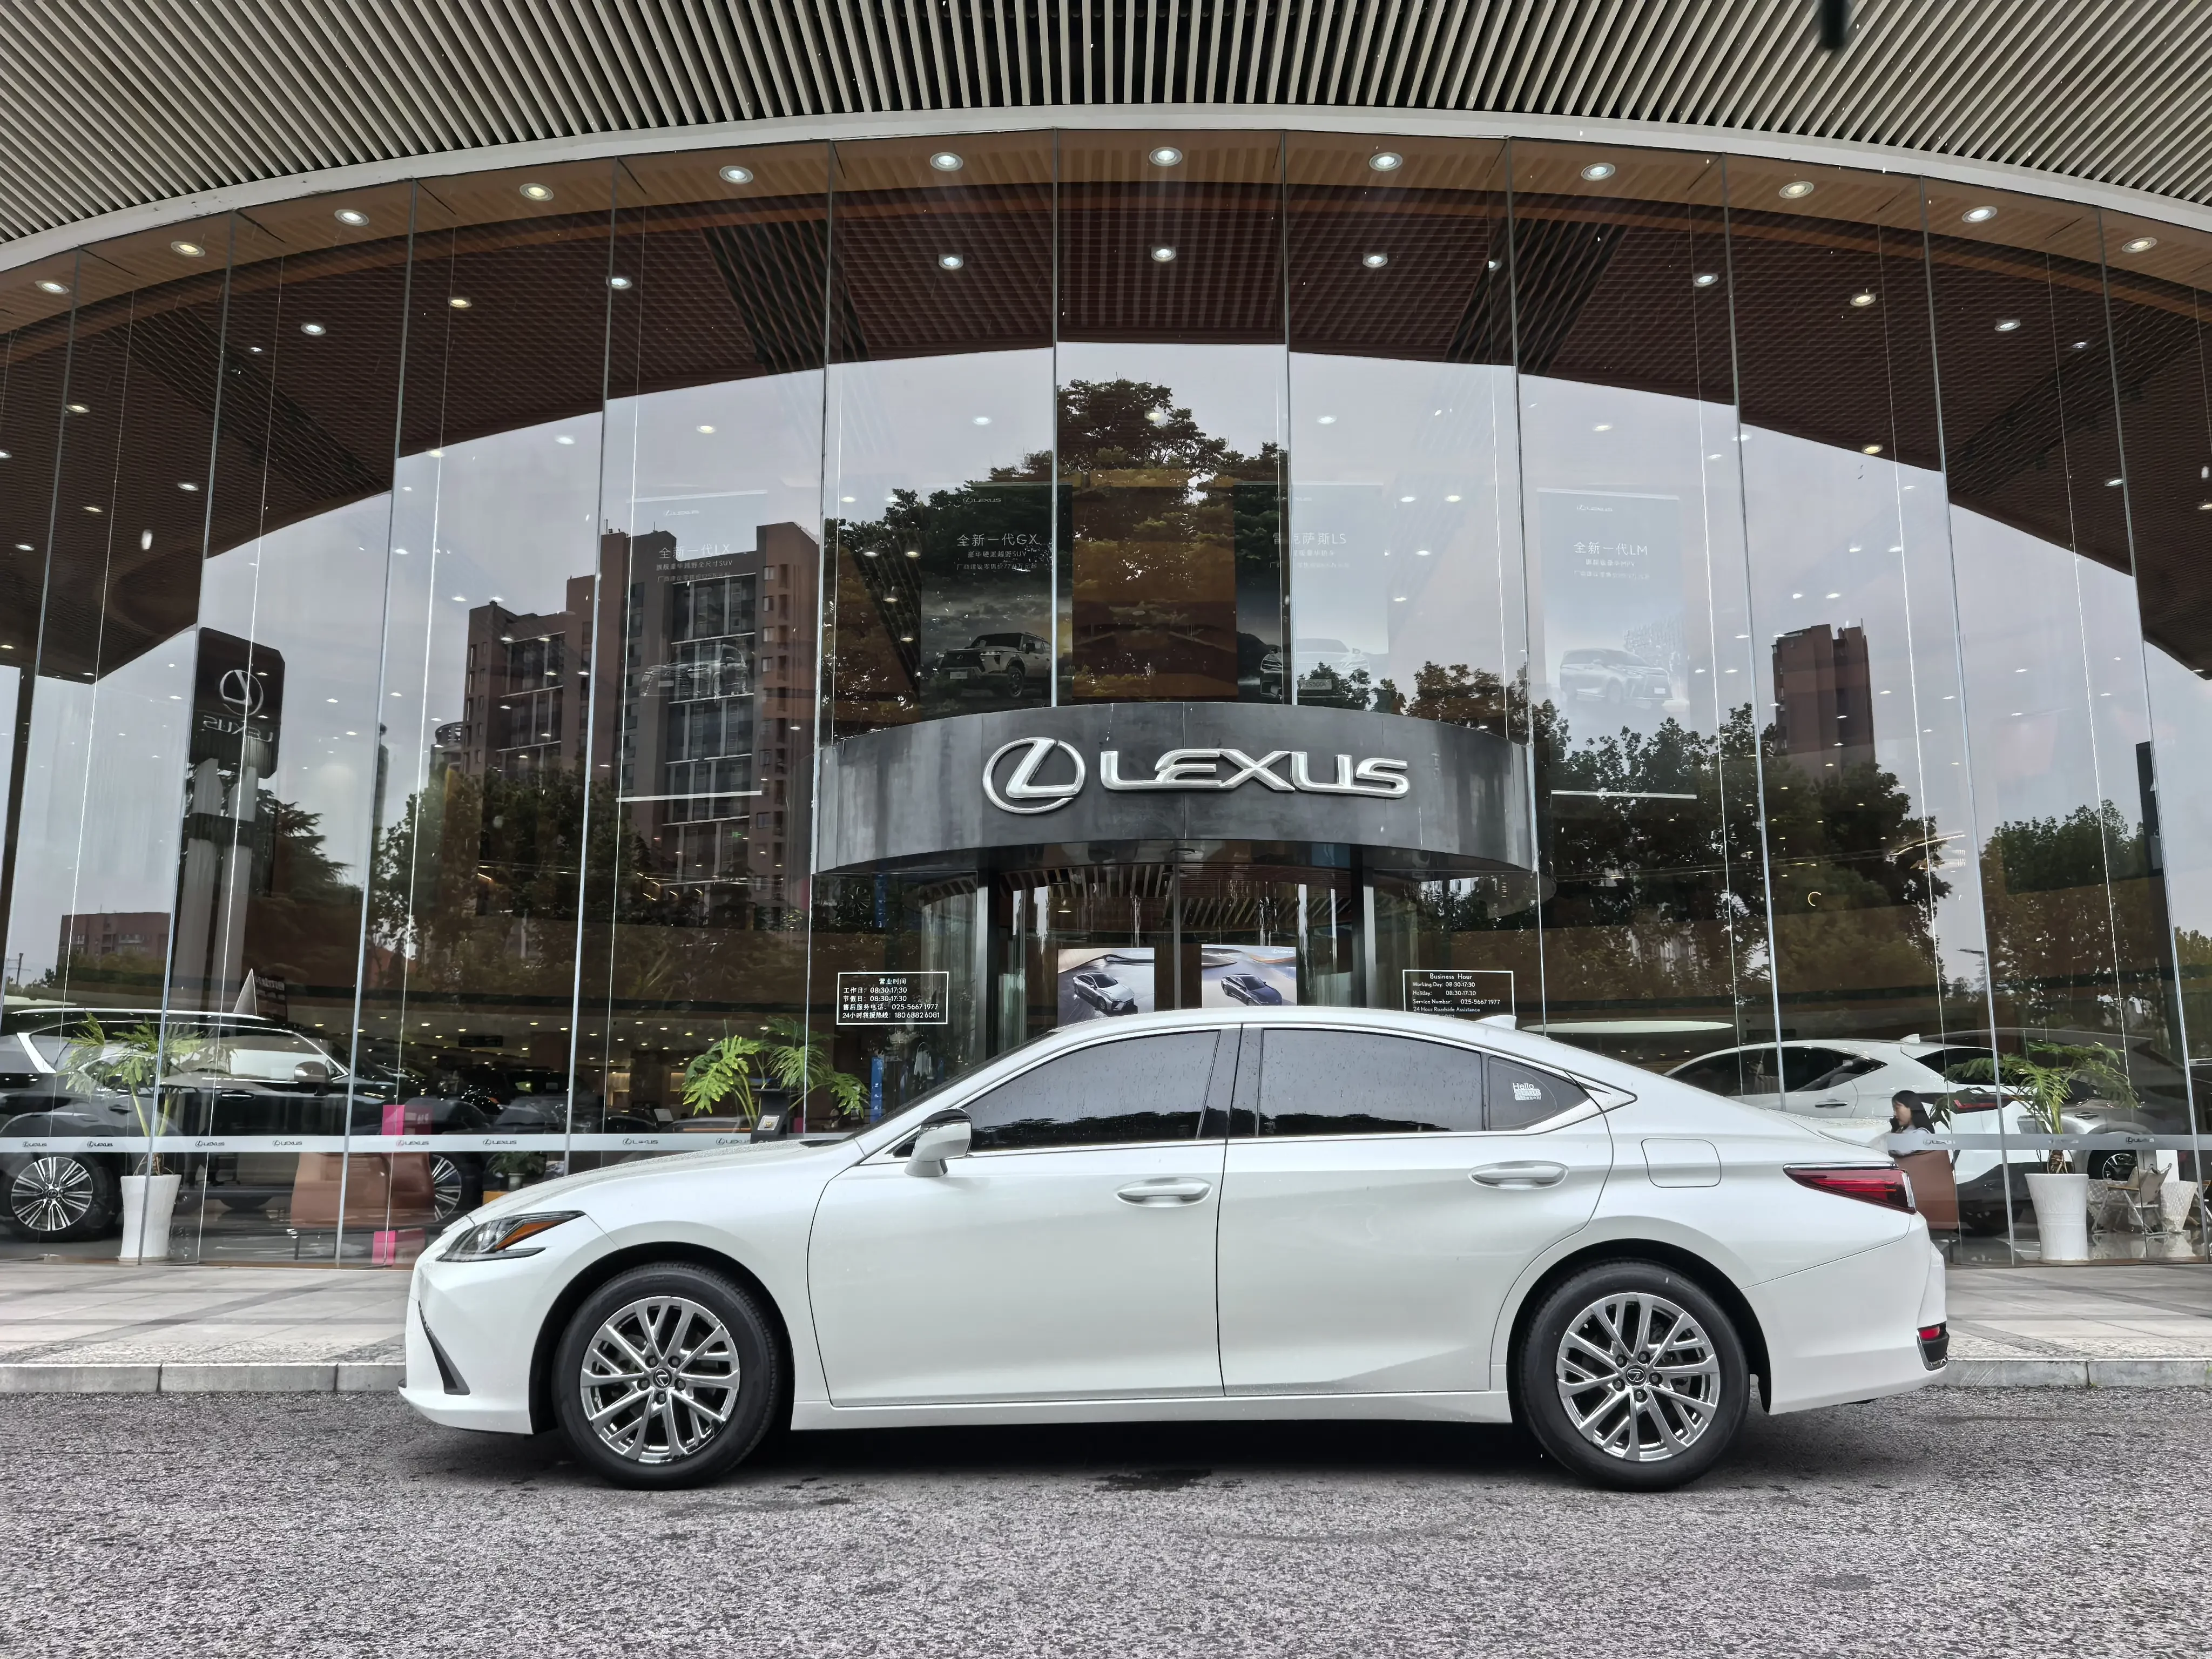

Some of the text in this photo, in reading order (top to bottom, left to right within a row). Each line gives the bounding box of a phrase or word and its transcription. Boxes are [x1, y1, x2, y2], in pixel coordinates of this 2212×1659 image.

[956, 533, 1038, 547] 全新一代GX
[658, 543, 731, 559] 全新一代LX
[1574, 542, 1648, 556] 全新一代LM
[1100, 748, 1411, 799] LEXUS
